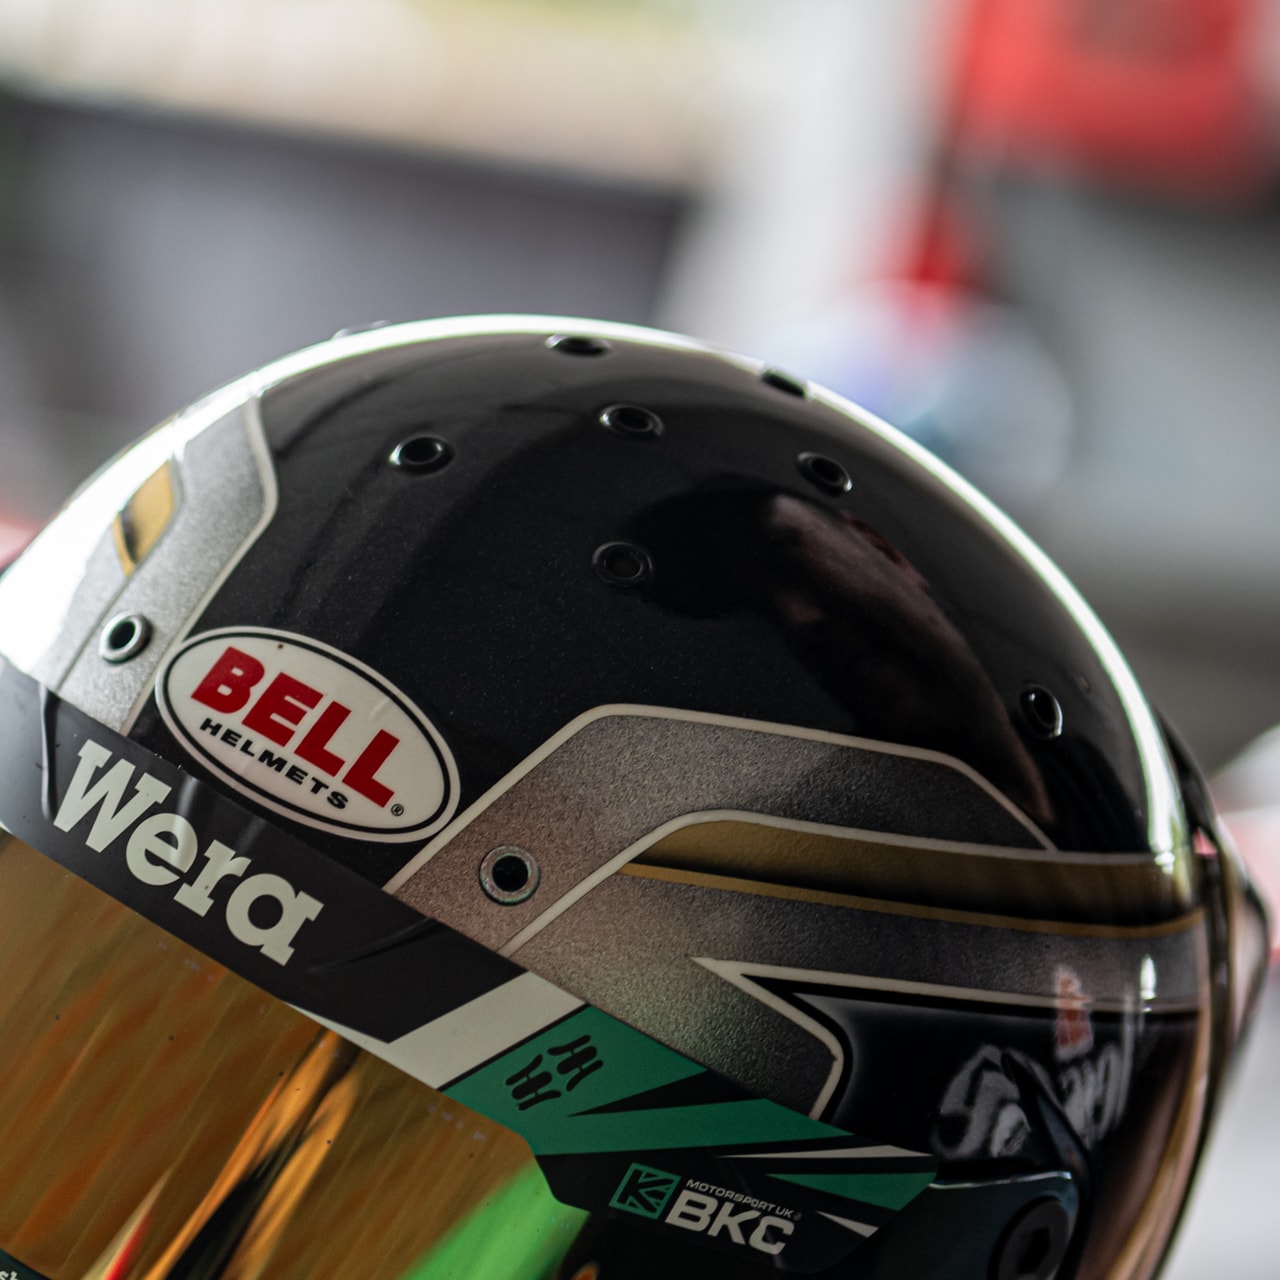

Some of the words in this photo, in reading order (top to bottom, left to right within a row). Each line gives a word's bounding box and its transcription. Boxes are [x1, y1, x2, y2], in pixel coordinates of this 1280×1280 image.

[191, 646, 400, 809] BELL
[199, 717, 350, 810] HELMETS
[52, 739, 325, 967] Wera
[664, 1189, 796, 1256] BKC
[685, 1178, 777, 1212] MOTORSPORT
[774, 1205, 796, 1219] UK
